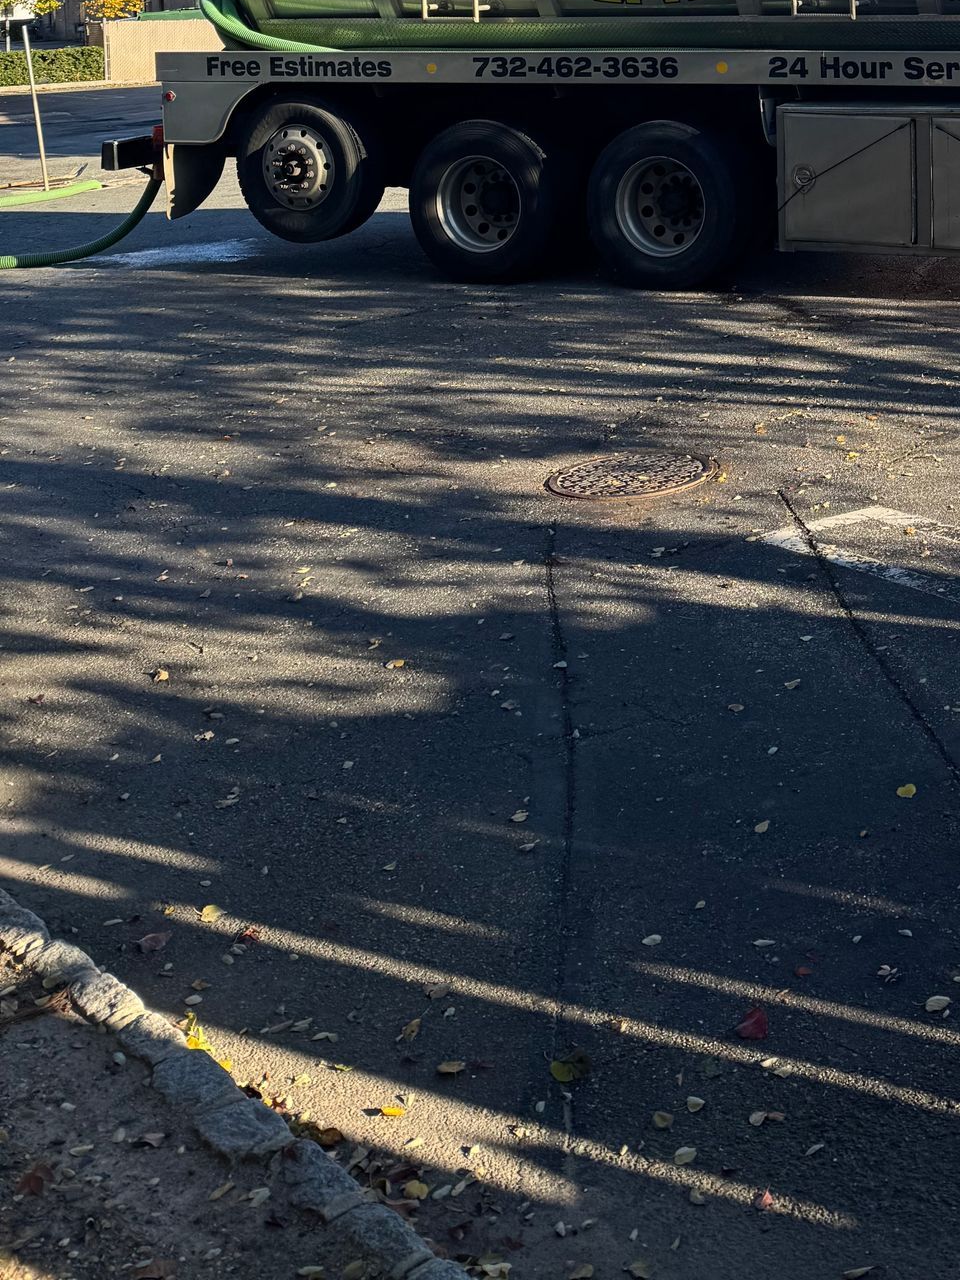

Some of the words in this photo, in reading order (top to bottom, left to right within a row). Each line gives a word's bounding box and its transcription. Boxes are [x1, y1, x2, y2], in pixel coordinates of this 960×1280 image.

[206, 56, 261, 77] Free
[269, 55, 392, 78] Estimates
[472, 56, 679, 79] 732-462-3636
[768, 55, 809, 79] 24
[820, 56, 893, 80] Hour
